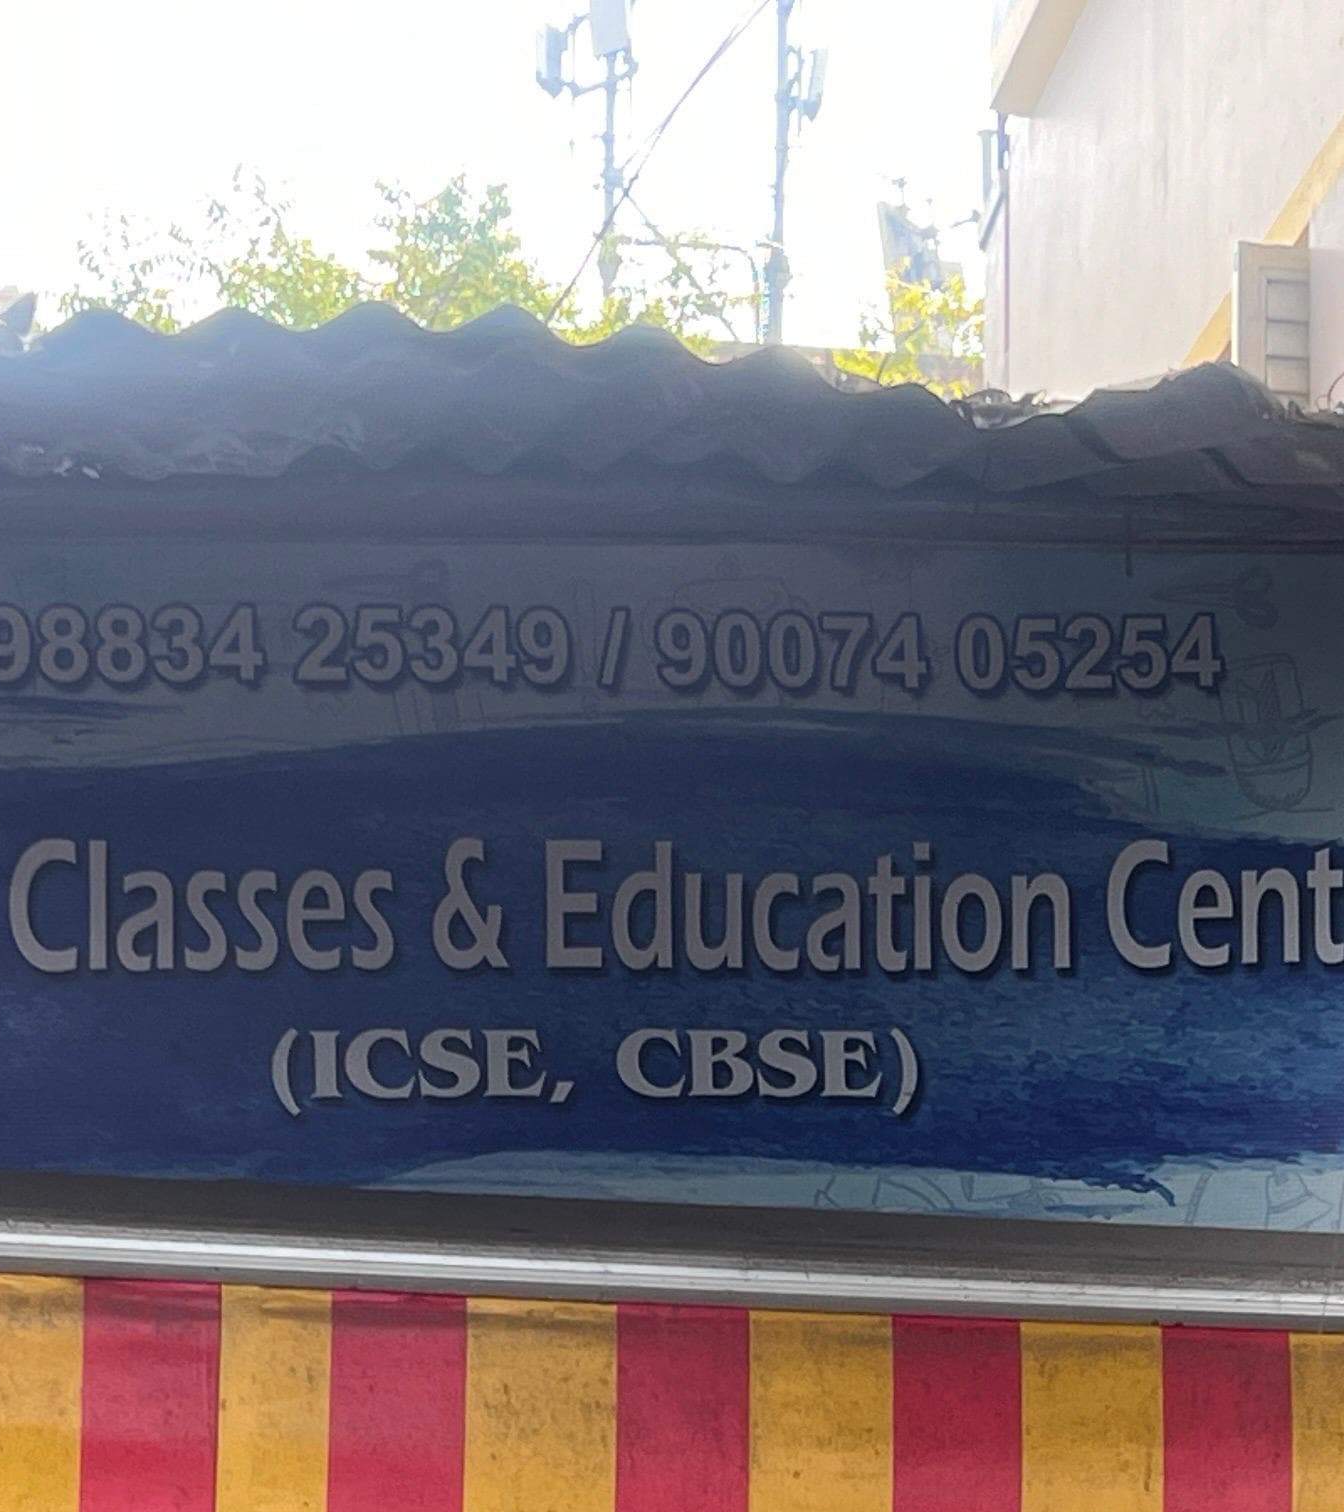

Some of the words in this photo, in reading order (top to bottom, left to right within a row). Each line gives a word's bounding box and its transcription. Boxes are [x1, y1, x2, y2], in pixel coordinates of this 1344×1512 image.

[293, 606, 570, 685] 25349
[599, 608, 629, 687] /
[658, 611, 930, 690] 90074
[957, 613, 1223, 690] 05254
[7, 836, 396, 973] Classes
[431, 837, 510, 971] &
[544, 838, 1072, 973] Education
[271, 1025, 574, 1118] (ICSE,
[616, 1026, 920, 1117] CBSE)
